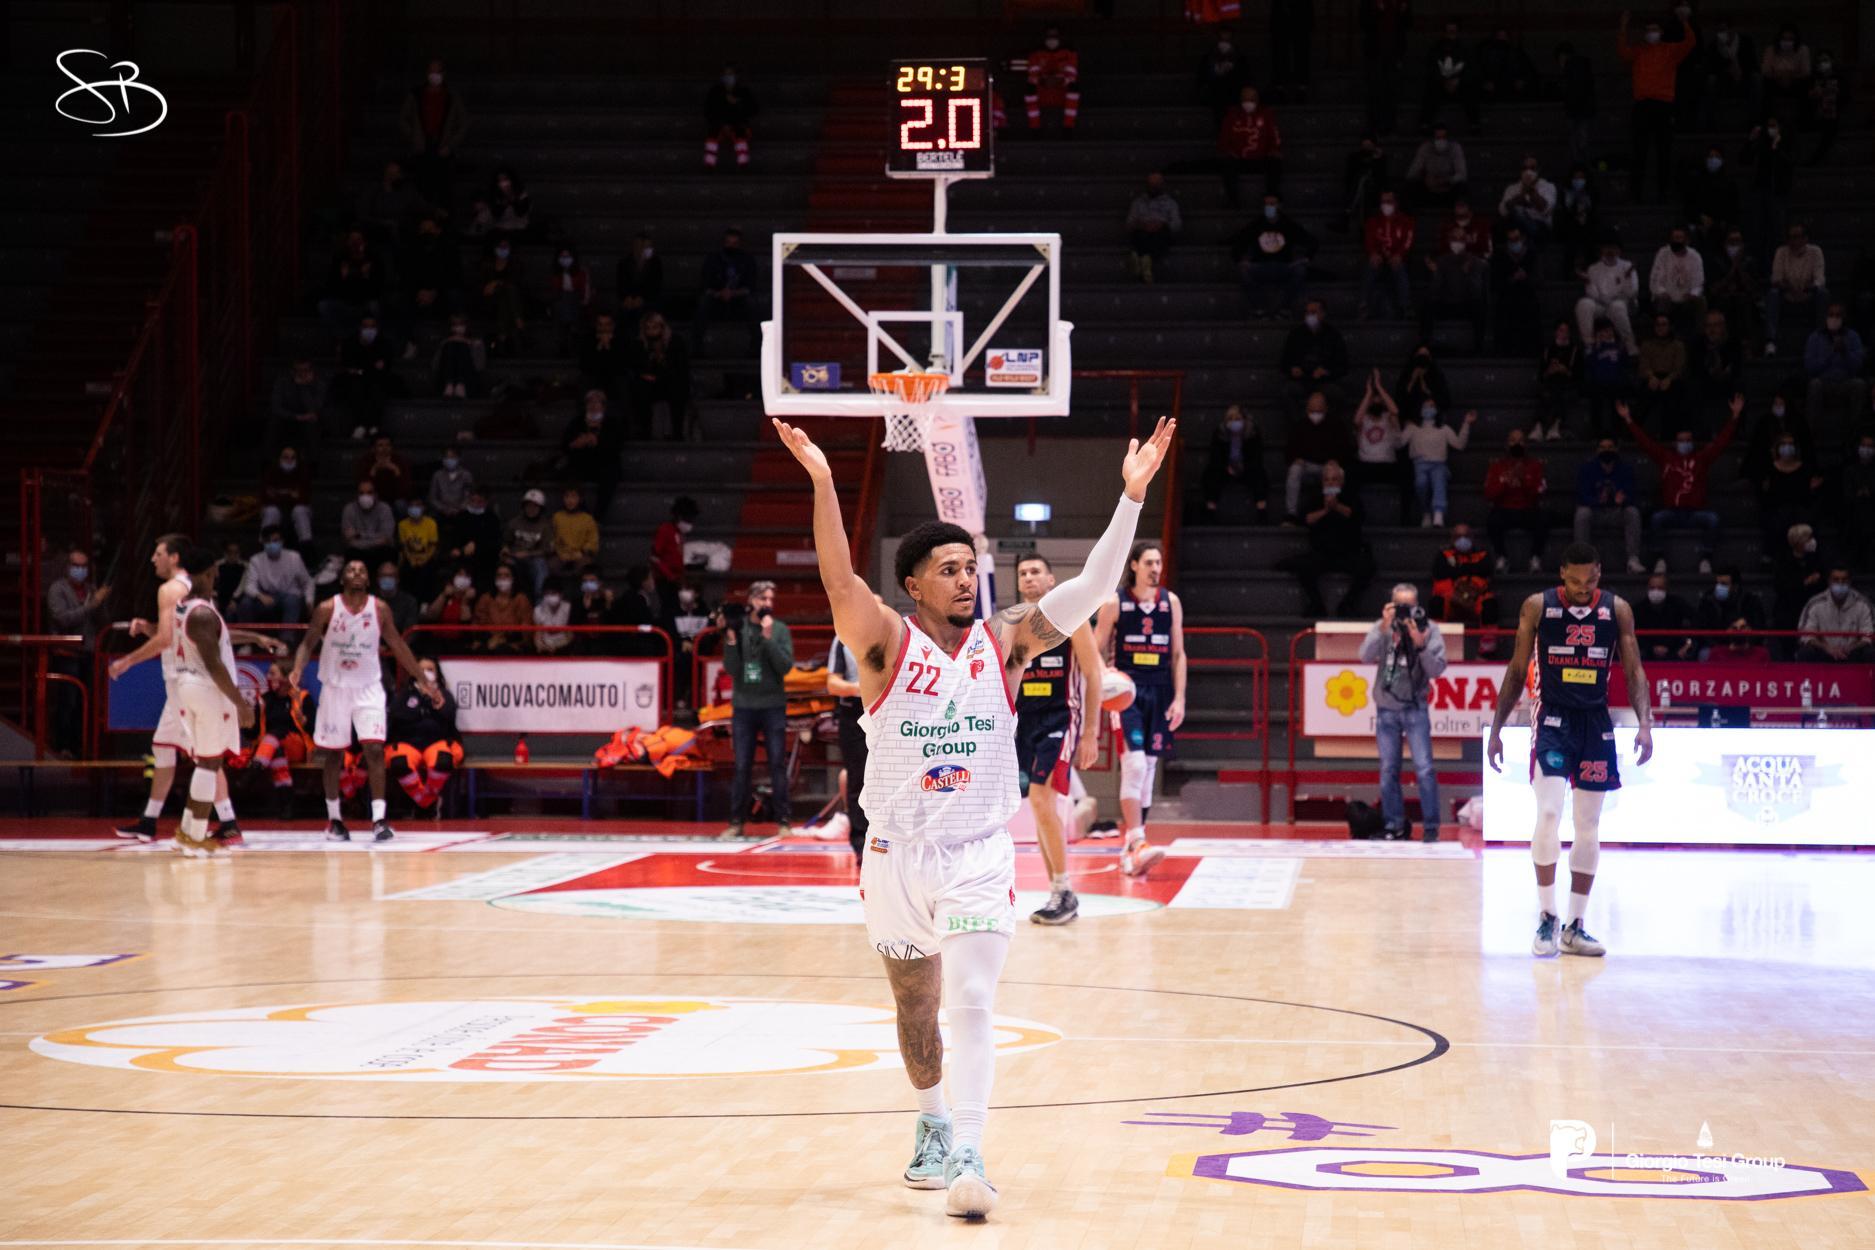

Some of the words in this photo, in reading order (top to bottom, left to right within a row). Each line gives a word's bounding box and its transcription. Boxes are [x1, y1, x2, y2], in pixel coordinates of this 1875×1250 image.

[900, 98, 980, 149] 2.0
[1005, 352, 1039, 362] LNP
[1566, 624, 1596, 646] 25
[905, 661, 941, 696] 22
[476, 684, 618, 708] NUOVACOMAUTO
[900, 720, 960, 739] Giorgio
[963, 715, 995, 731] Tesi
[1434, 716, 1471, 732] oltre
[922, 741, 977, 757] Group
[1579, 760, 1608, 782] 25
[1733, 756, 1802, 774] ACQUA
[1733, 772, 1803, 790] SANTA
